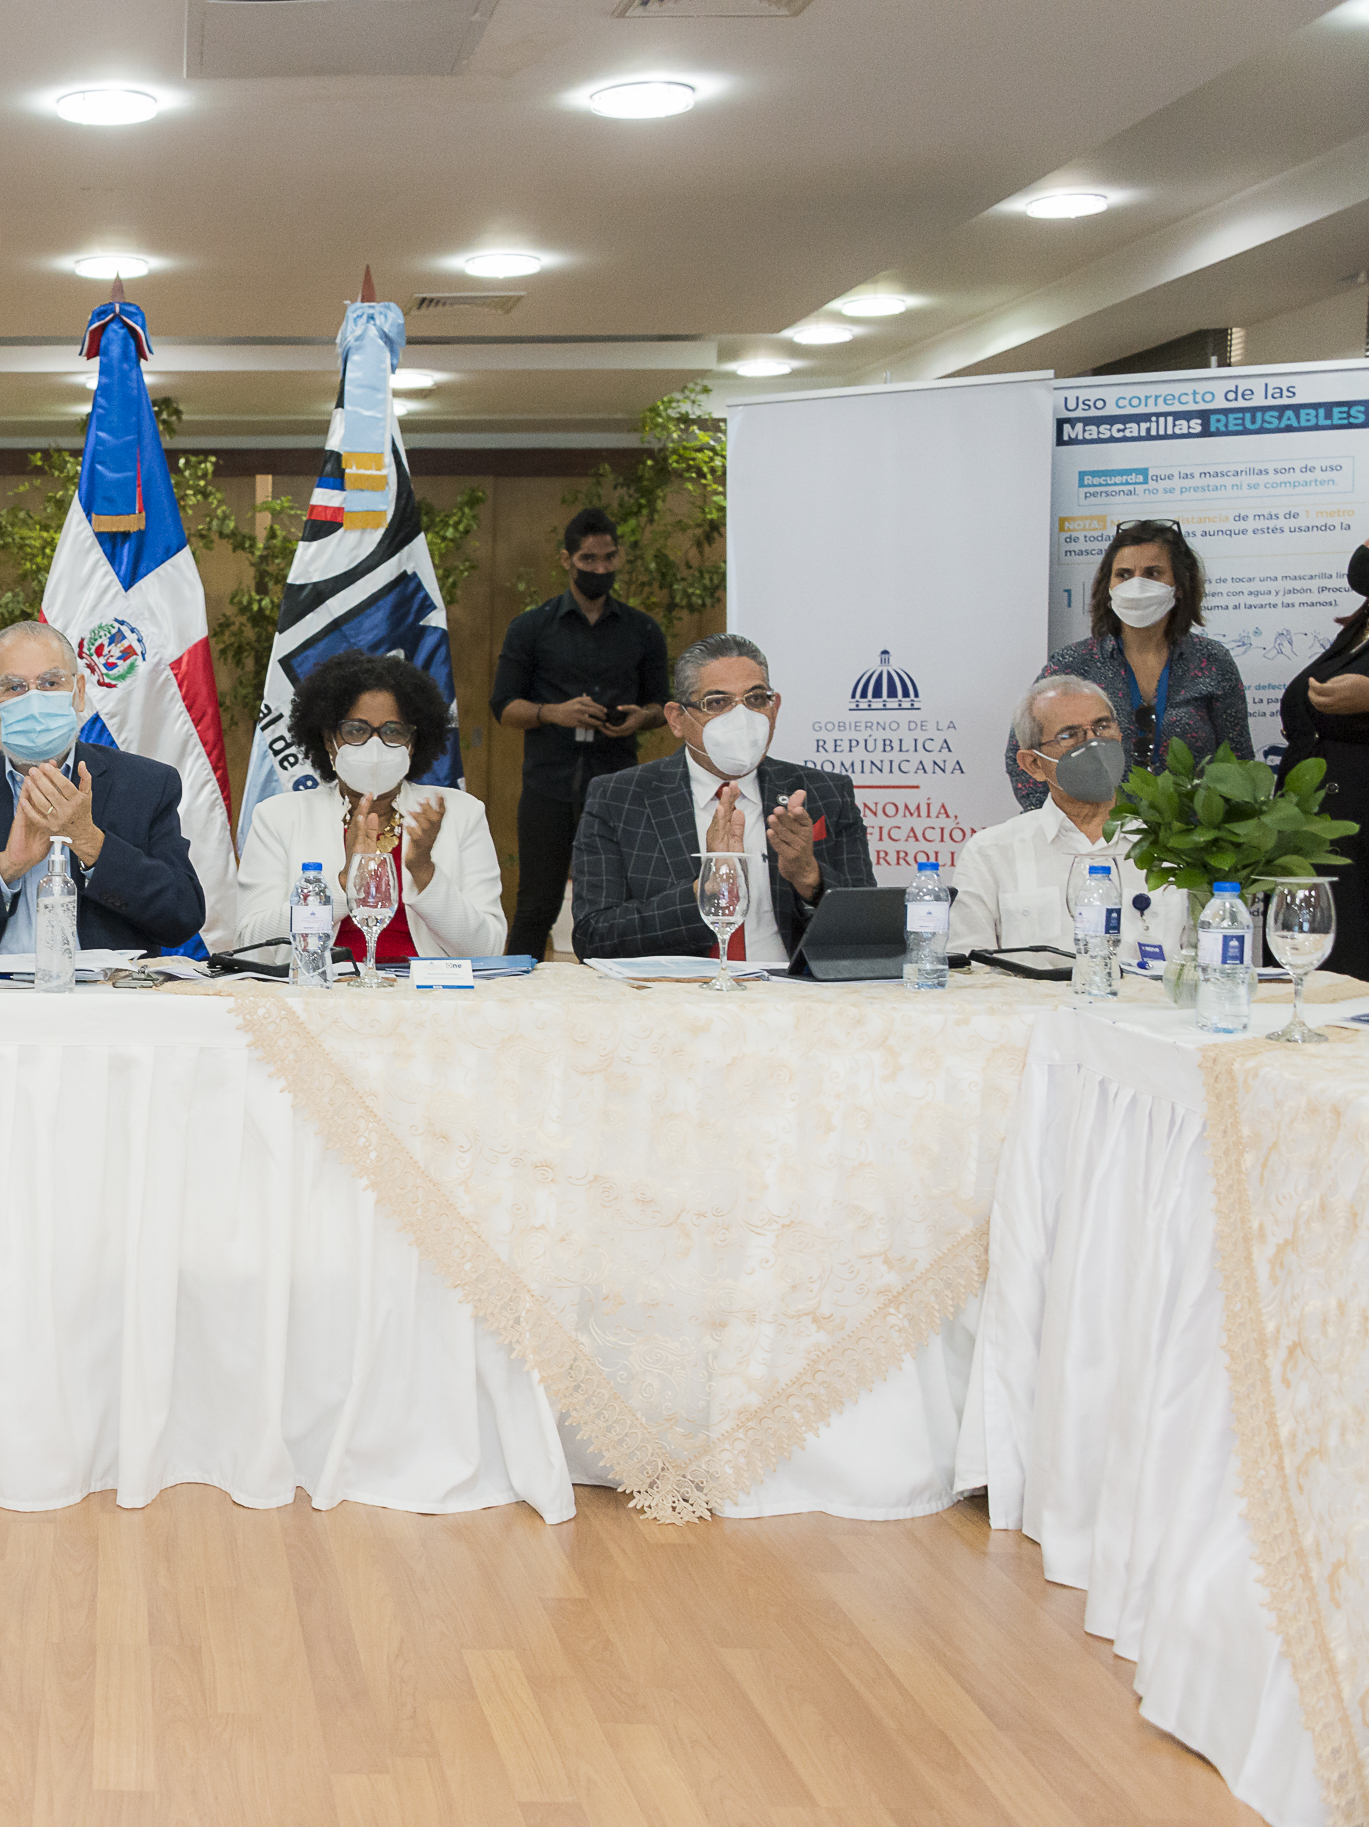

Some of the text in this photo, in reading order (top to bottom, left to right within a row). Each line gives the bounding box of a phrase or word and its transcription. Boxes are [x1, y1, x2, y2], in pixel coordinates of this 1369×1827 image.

[1063, 383, 1296, 412] Uso correcto de las
[1063, 405, 1366, 441] Mascarillas REUSABLES
[1083, 463, 1343, 485] Recuerda que las mascarillas son de uso
[1084, 487, 1139, 500] personal,
[1143, 487, 1158, 496] no
[1162, 486, 1176, 495] se
[1180, 481, 1227, 495] prestan
[1232, 481, 1242, 490] ni
[1247, 481, 1260, 489] se
[1233, 512, 1249, 522] de
[1253, 511, 1280, 521] más
[1284, 510, 1300, 520] de
[1305, 509, 1310, 518] 1
[1316, 508, 1355, 518] metro
[1064, 534, 1080, 543] de
[1201, 528, 1248, 539] aunque
[1252, 525, 1284, 534] estés
[1289, 522, 1336, 533] usando
[1340, 521, 1351, 531] la
[1215, 576, 1227, 584] de
[1231, 575, 1255, 583] tocar
[1259, 574, 1278, 582] una
[1282, 571, 1332, 581] mascarilla
[1063, 588, 1072, 608] 1
[1247, 589, 1272, 597] agua
[1275, 589, 1280, 597] y
[1232, 602, 1241, 610] al
[1244, 601, 1278, 609] lavarte
[812, 720, 957, 732] GOBIERNO DE LA
[268, 735, 299, 771] de
[815, 734, 953, 753] REPÚBLICA
[855, 797, 958, 821] NOMÍA,
